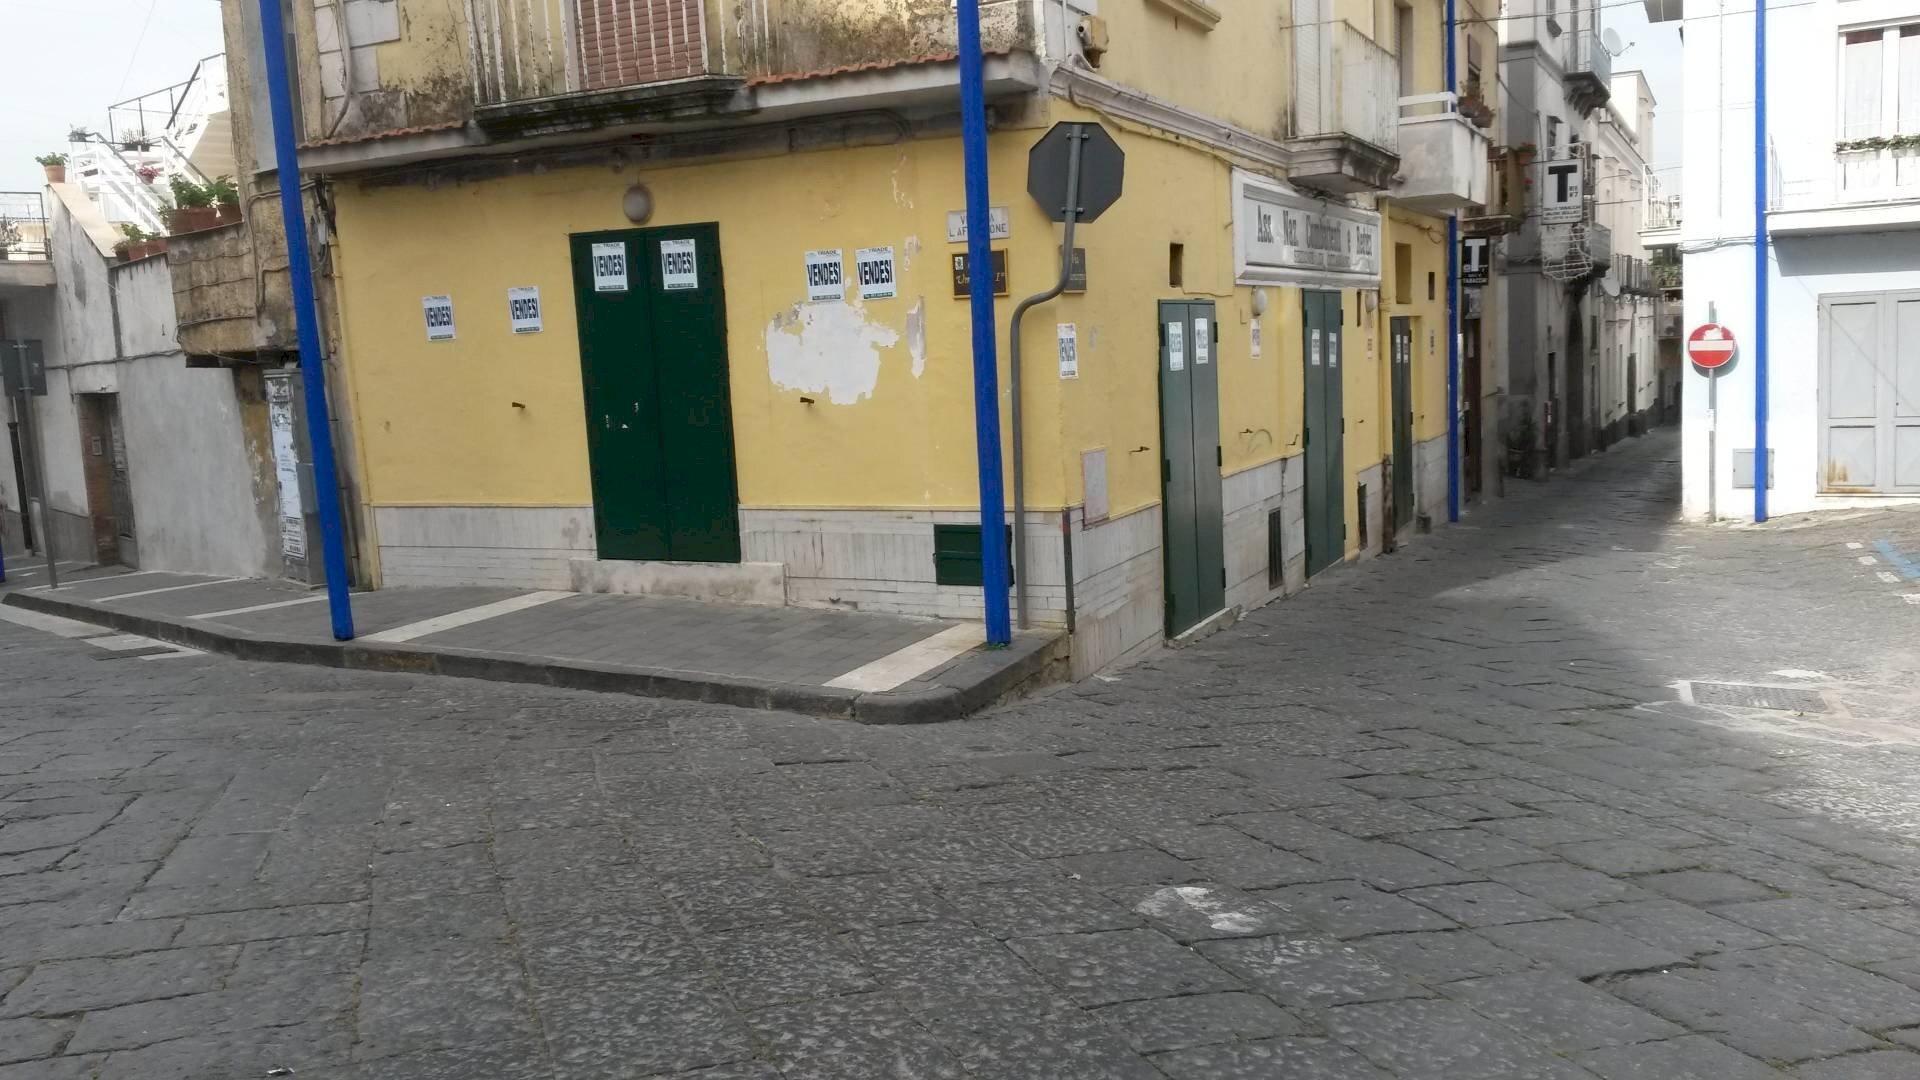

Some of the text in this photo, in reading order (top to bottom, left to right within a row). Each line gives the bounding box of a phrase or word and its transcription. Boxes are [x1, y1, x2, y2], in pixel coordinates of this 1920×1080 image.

[1548, 164, 1578, 203] T
[594, 254, 625, 277] VENDESI
[662, 252, 694, 275] VENDESI
[1465, 238, 1487, 272] T
[807, 262, 842, 286] VENDESI
[857, 260, 893, 285] VENDESI
[424, 306, 452, 328] VENDESI
[510, 298, 540, 320] VENDESI
